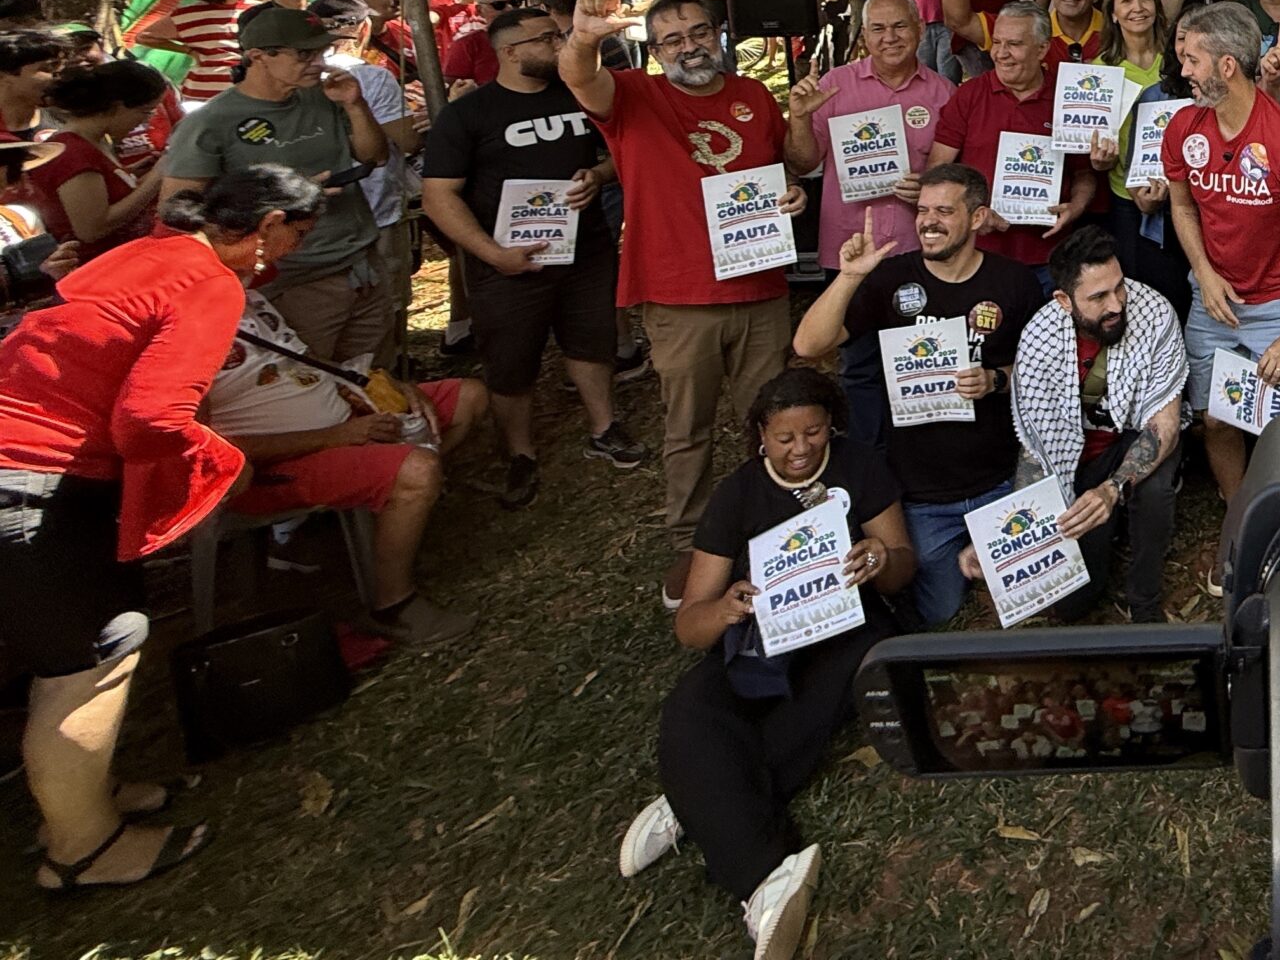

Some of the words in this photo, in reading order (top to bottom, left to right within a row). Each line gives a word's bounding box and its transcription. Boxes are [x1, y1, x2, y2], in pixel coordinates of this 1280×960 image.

[1063, 91, 1113, 102] CONCLAT
[1063, 114, 1108, 125] PAUTA
[504, 111, 589, 147] CUT
[843, 138, 896, 154] CONCLAT
[848, 161, 898, 176] PAUTA
[1005, 163, 1054, 175] CONCLAT
[1188, 169, 1271, 197] CULTURA
[1003, 185, 1048, 198] PAUTA
[511, 208, 568, 218] CONCLAT
[717, 199, 777, 218] CONCLAT
[511, 229, 564, 239] PAUTA
[723, 223, 780, 244] PAUTA
[976, 316, 996, 329] 6X1
[895, 357, 958, 372] CONCLAT
[900, 380, 956, 396] PAUTA
[1243, 372, 1257, 423] CONCLAT
[813, 531, 835, 544] 2030
[986, 537, 1008, 550] 2026
[1035, 514, 1056, 528] 2030
[990, 522, 1058, 560] CONCLAT
[764, 539, 837, 578] CONCLAT
[1001, 549, 1066, 588] PAUTA
[769, 573, 840, 610] PAUTA
